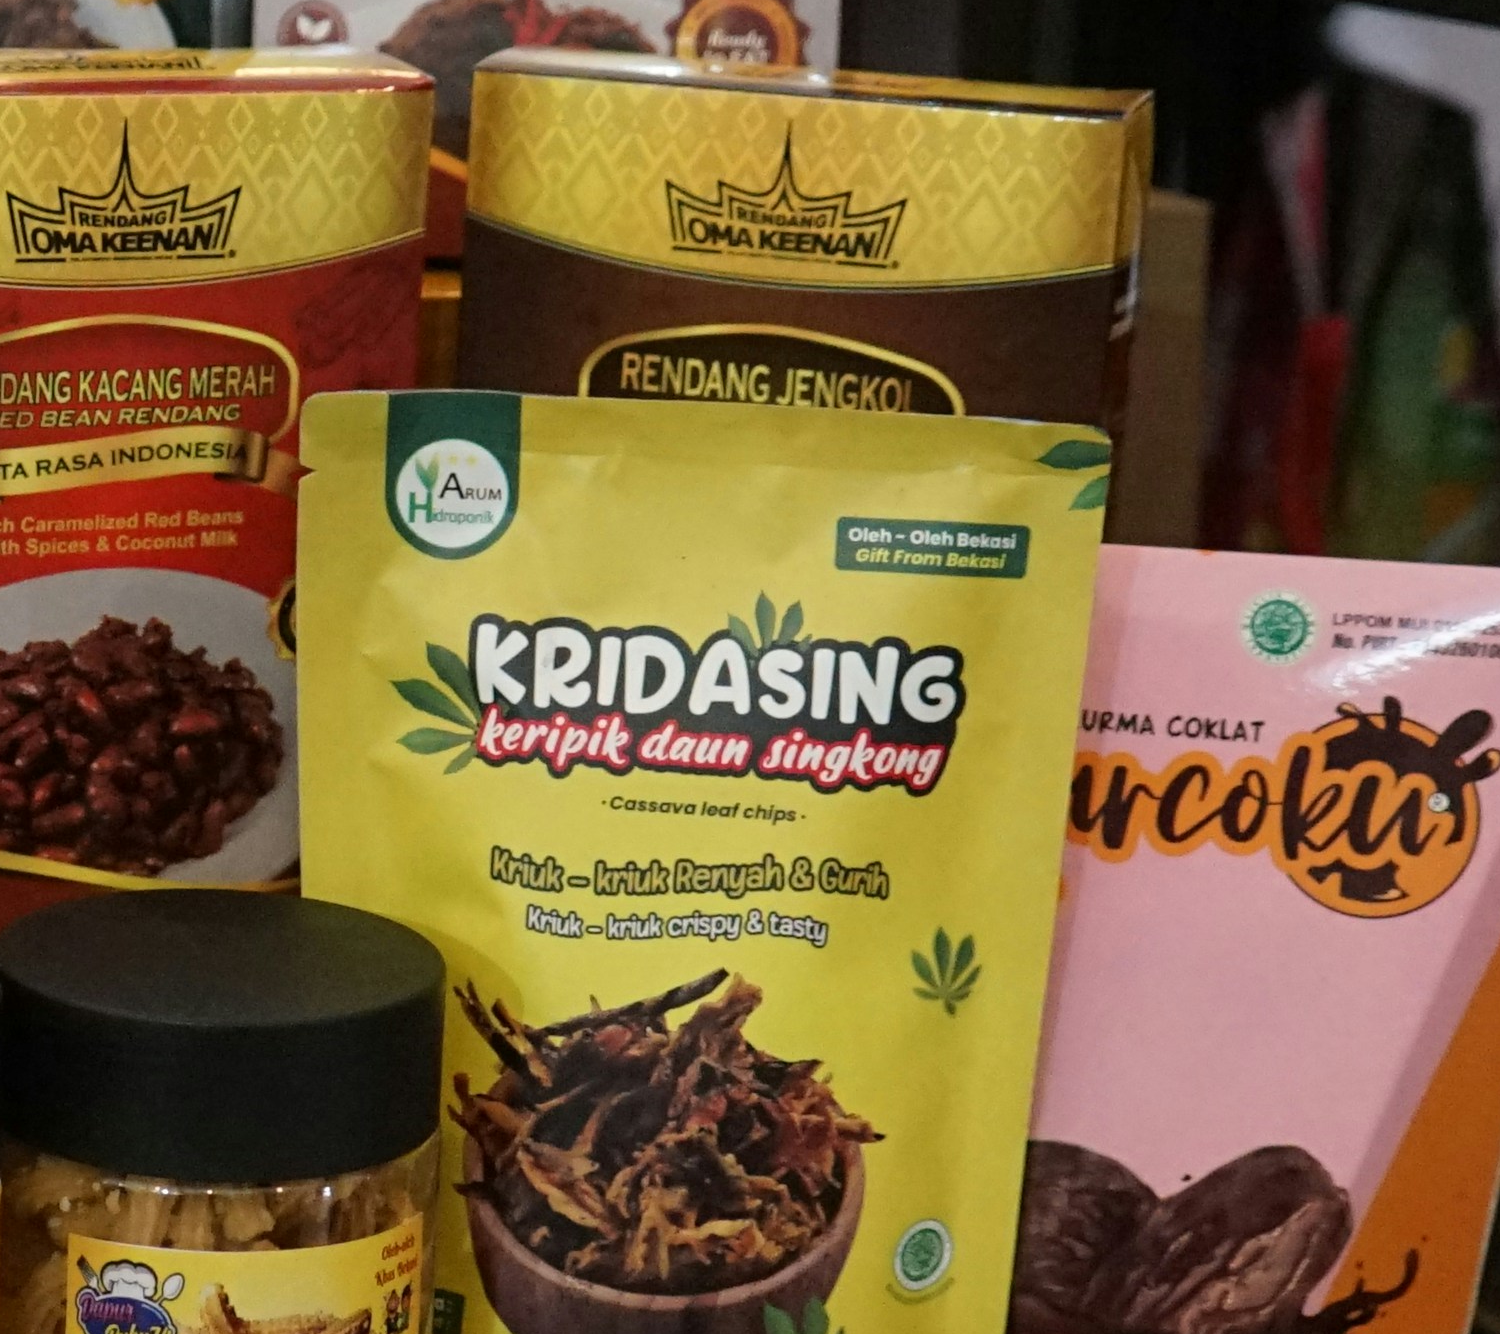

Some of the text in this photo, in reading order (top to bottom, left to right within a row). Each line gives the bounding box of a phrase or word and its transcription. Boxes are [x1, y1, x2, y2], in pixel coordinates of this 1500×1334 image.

[78, 210, 168, 228] RENDANG
[735, 206, 829, 229] RENDANG
[30, 222, 215, 254] OMA KEENAN
[688, 217, 877, 259] OMA KEENAN
[78, 367, 184, 405] KACANG
[189, 364, 276, 398] MERAH
[620, 352, 771, 404] RENDANG
[40, 407, 112, 428] BEAN
[117, 403, 241, 425] RENDANG
[35, 453, 104, 477] RASA
[110, 441, 248, 467] INDONESIA
[438, 472, 502, 502] ARUM
[20, 513, 140, 533] Caramelized
[144, 511, 181, 529] Red
[186, 509, 244, 527] Beans
[25, 536, 91, 558] Spices
[96, 536, 110, 552] &
[115, 533, 197, 552] Coconut
[201, 531, 238, 548] Milk
[847, 526, 892, 546] Oleh
[910, 528, 953, 549] Oleh
[956, 530, 1018, 552] Bekasi
[855, 547, 1007, 571] Gift From Bekasi
[475, 622, 957, 725] KRIDASING
[1080, 709, 1266, 744] URMA COKLAT
[479, 717, 946, 786] keripik daun singkong
[609, 795, 798, 825] Cassava leaf chips
[1070, 745, 1440, 861] urcoku
[490, 846, 890, 900] Kriuk kriuk Renyah & Gurih
[526, 904, 830, 948] Kriuk kriuk crispy & tasty
